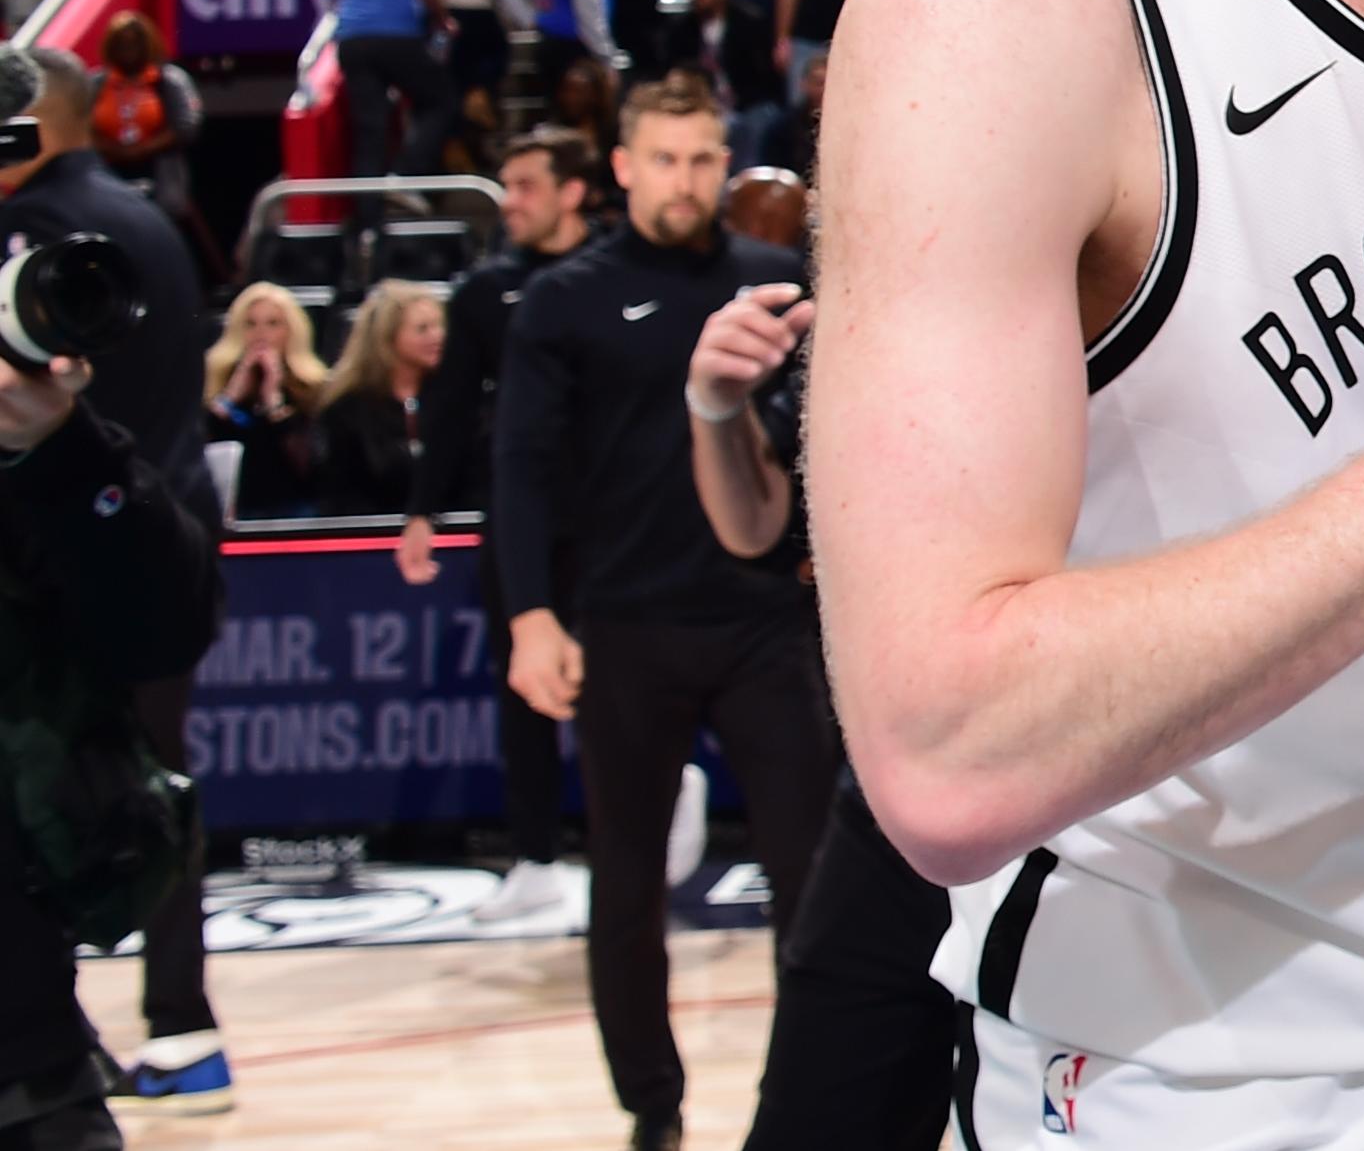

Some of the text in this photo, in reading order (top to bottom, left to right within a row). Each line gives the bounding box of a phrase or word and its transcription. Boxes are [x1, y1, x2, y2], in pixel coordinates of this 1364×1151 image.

[349, 610, 409, 682] 12
[183, 694, 502, 779] STONS.COM
[241, 835, 366, 868] StockX
